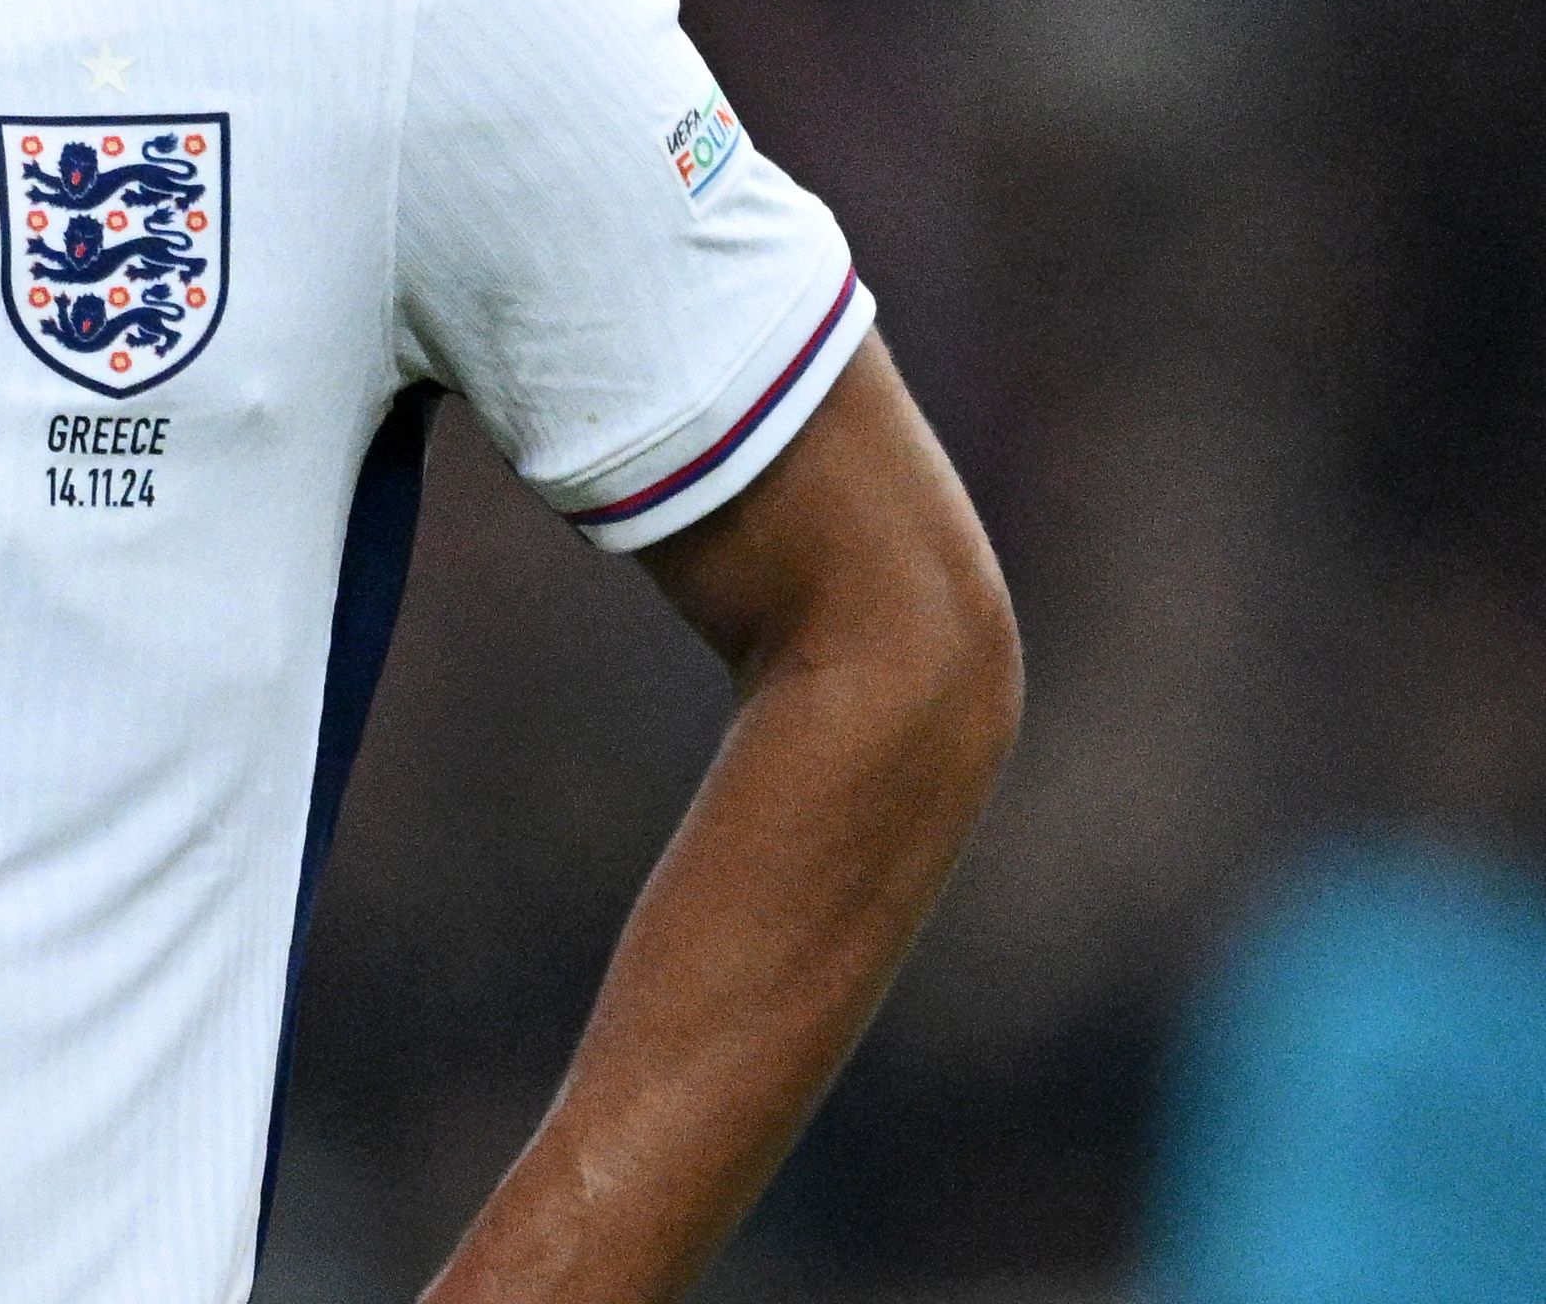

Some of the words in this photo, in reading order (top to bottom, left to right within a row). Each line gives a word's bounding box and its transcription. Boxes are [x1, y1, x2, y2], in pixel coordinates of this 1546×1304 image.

[666, 107, 703, 155] UEFA
[47, 414, 171, 456] GREECE
[46, 466, 156, 508] 14.11.24
